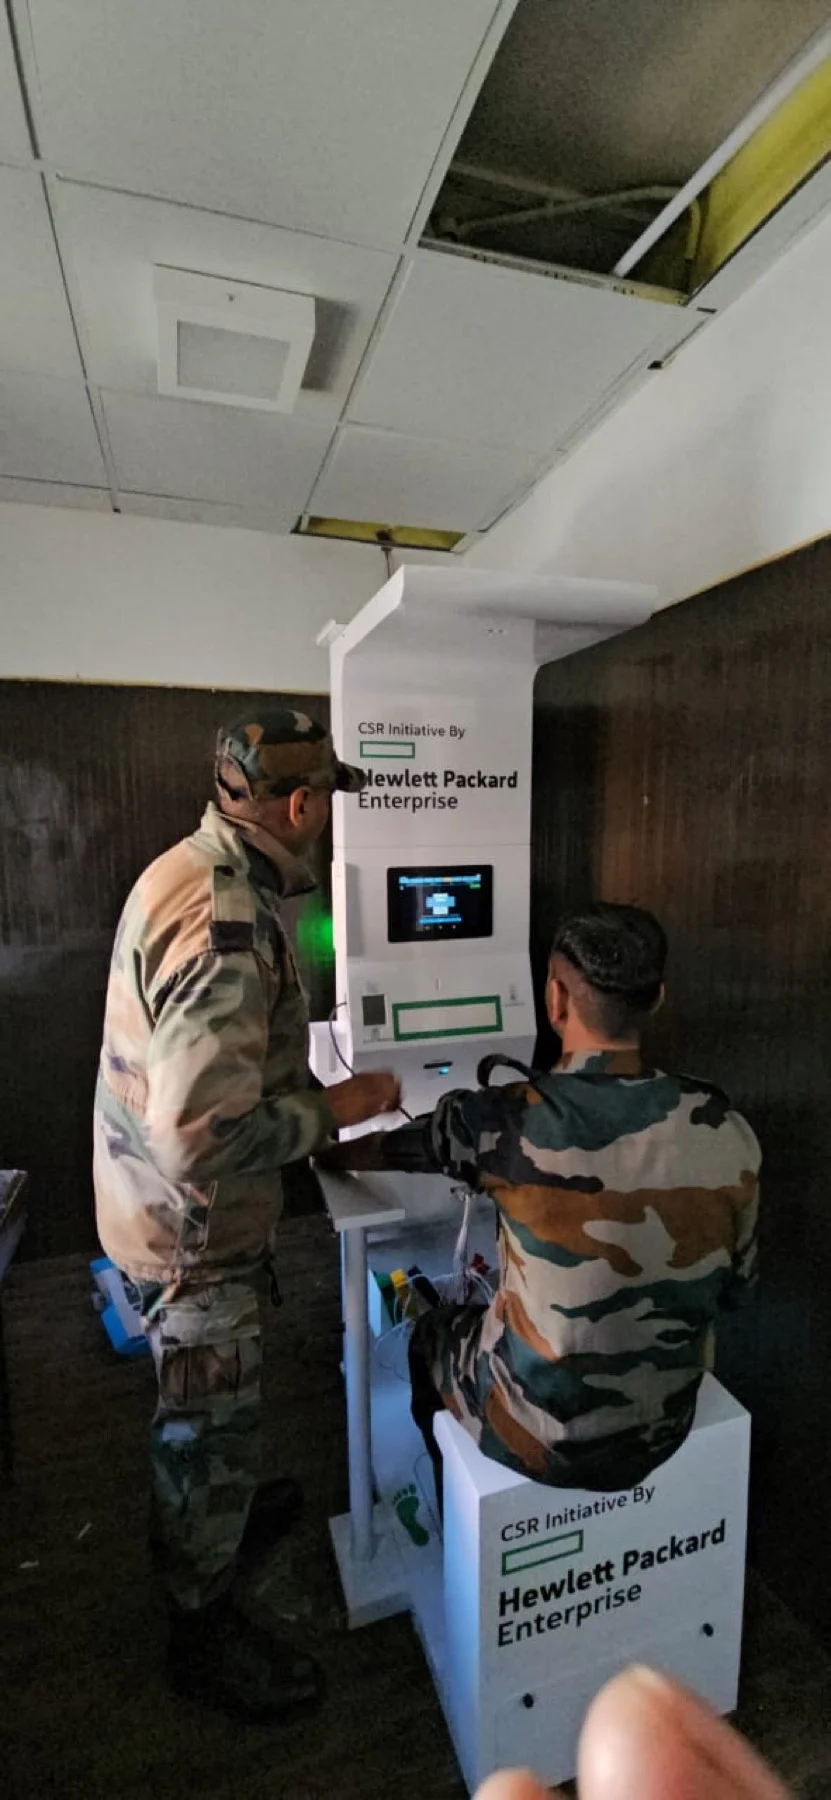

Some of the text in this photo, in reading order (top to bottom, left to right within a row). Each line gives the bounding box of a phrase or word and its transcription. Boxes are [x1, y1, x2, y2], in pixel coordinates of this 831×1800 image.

[358, 722, 466, 739] CSR Initiative By
[444, 770, 518, 788] Packard
[358, 791, 458, 813] Enterprise
[501, 1484, 656, 1542] CSR Initiative By
[499, 1518, 726, 1617] Hewlett Packard
[498, 1583, 642, 1648] Enterprise
